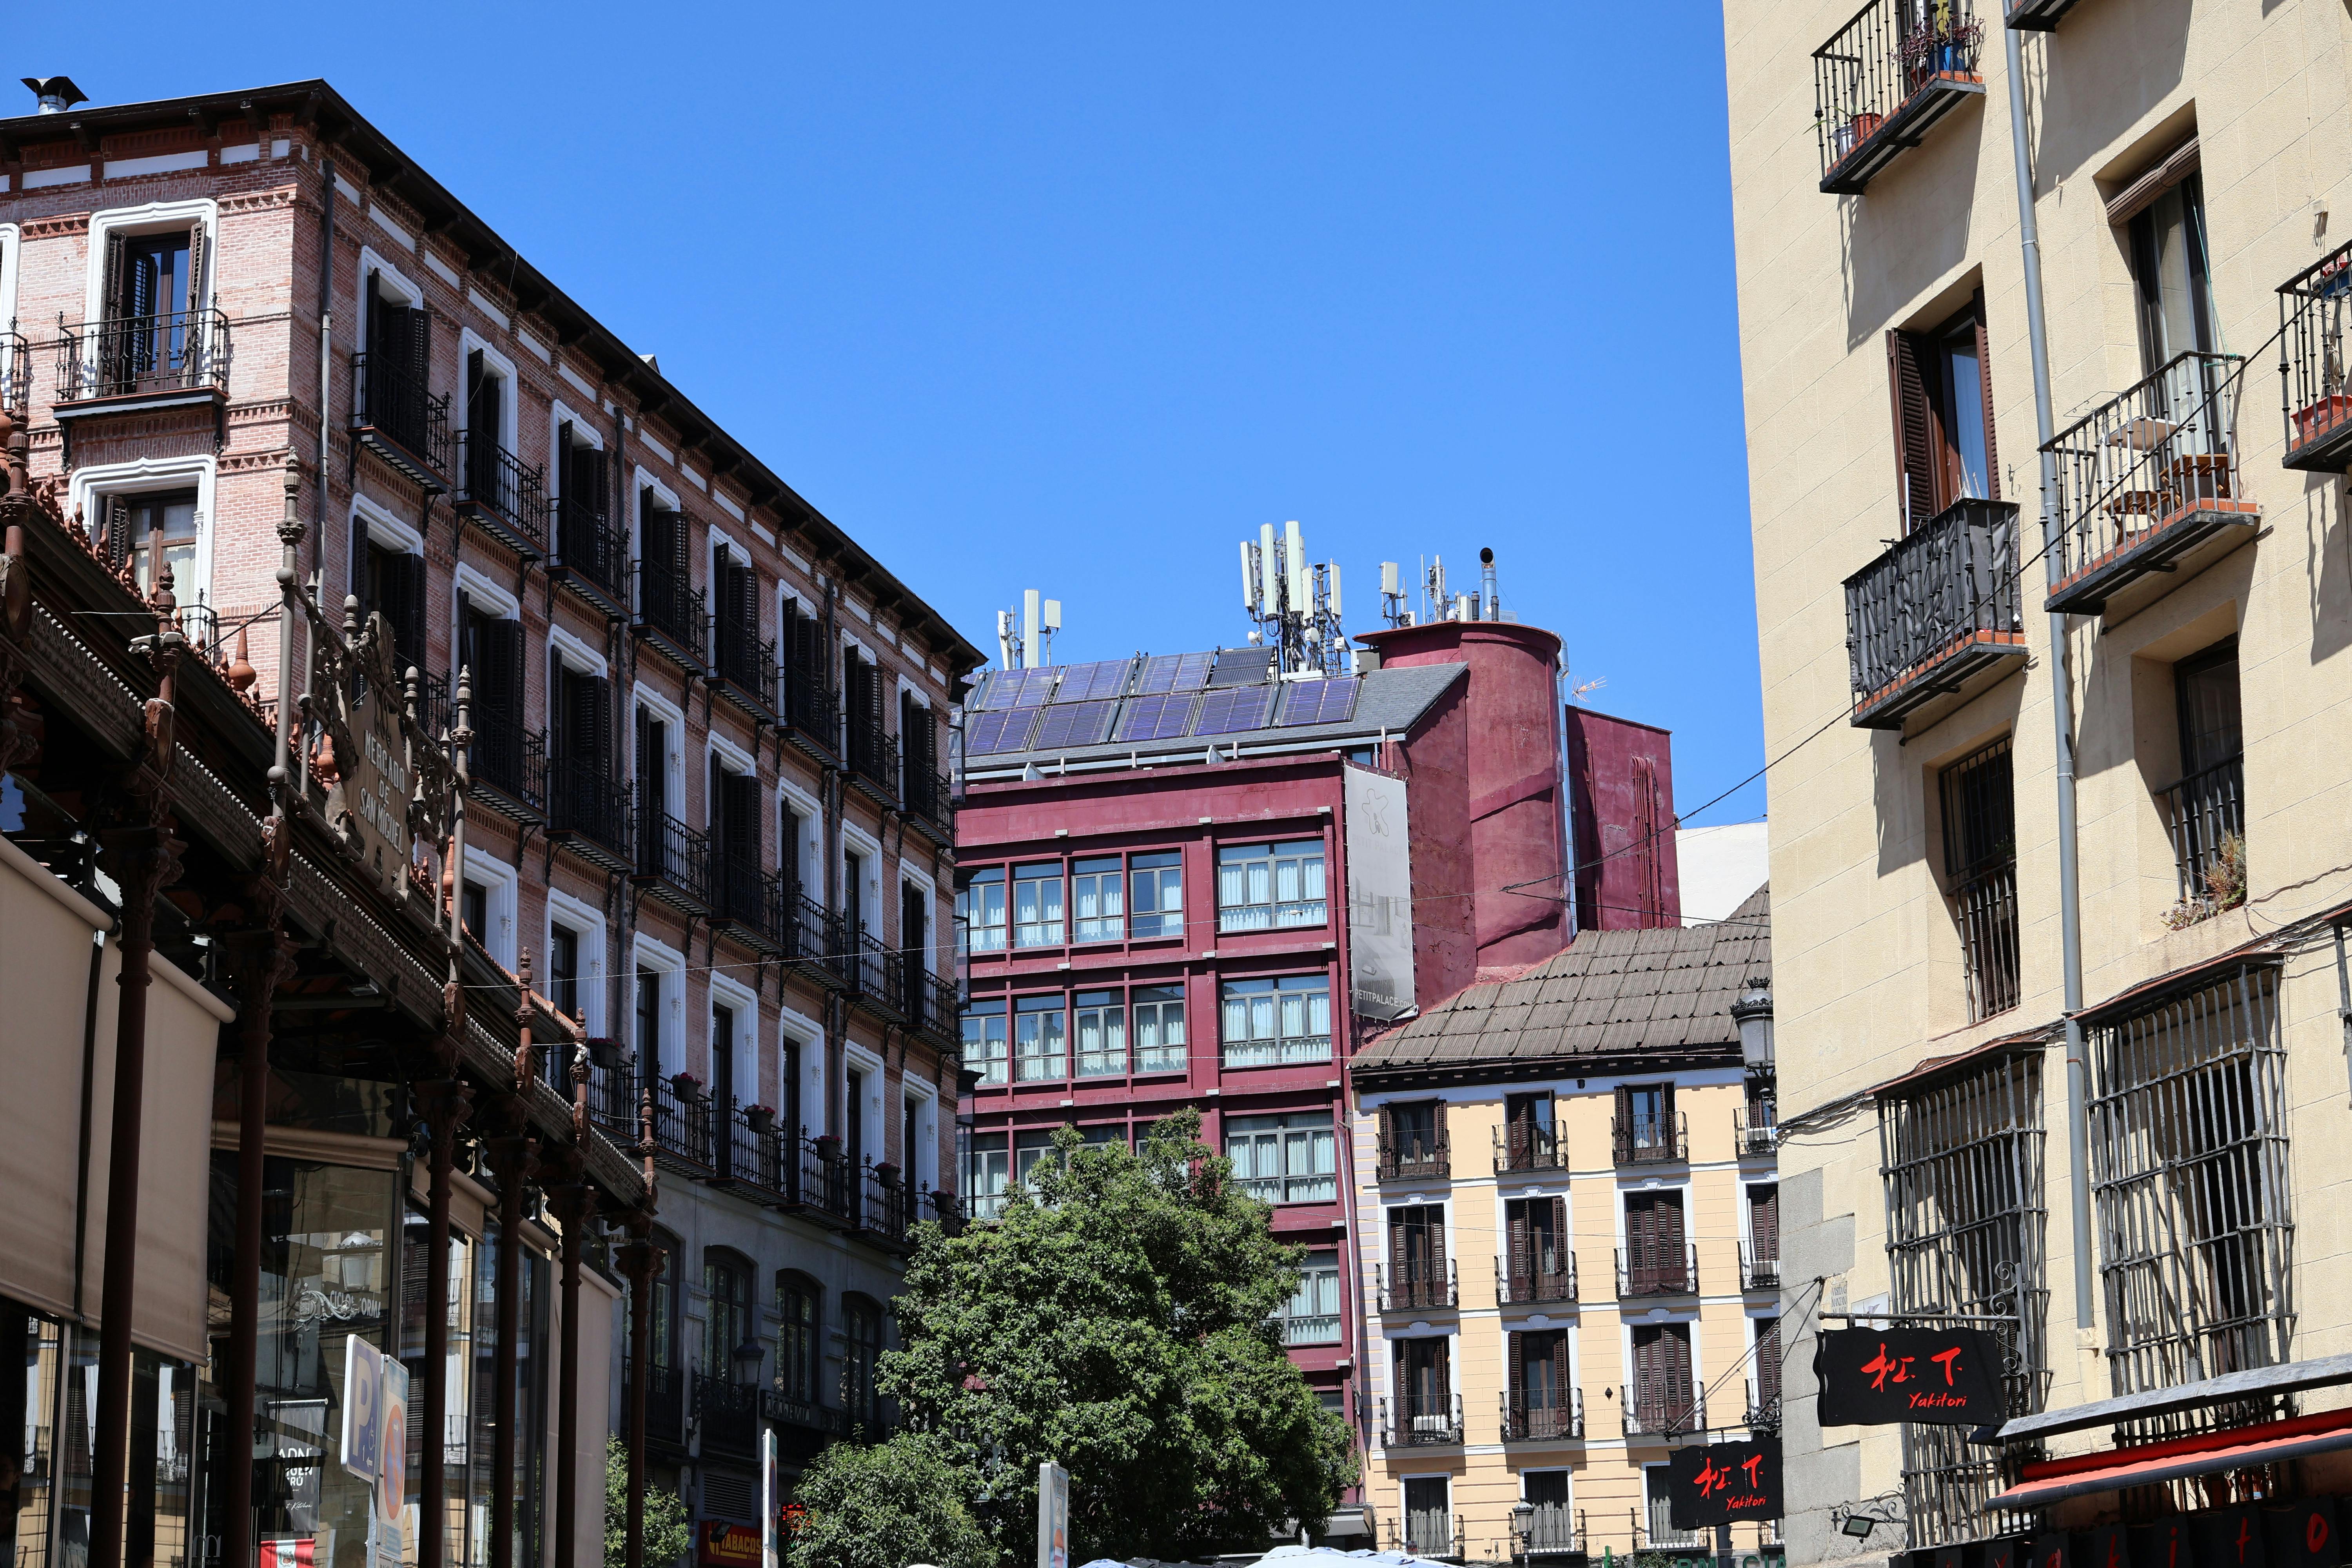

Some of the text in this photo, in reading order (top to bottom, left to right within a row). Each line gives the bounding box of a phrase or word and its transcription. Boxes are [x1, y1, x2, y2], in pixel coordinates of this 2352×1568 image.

[364, 729, 405, 795] MERCADO
[379, 779, 390, 805] DE
[360, 787, 403, 855] SAN MIGUEL
[353, 1356, 373, 1457] P
[766, 1396, 811, 1424] ACADEMIA
[1909, 1392, 1967, 1409] Yakitori
[1726, 1494, 1767, 1511] Yakitori
